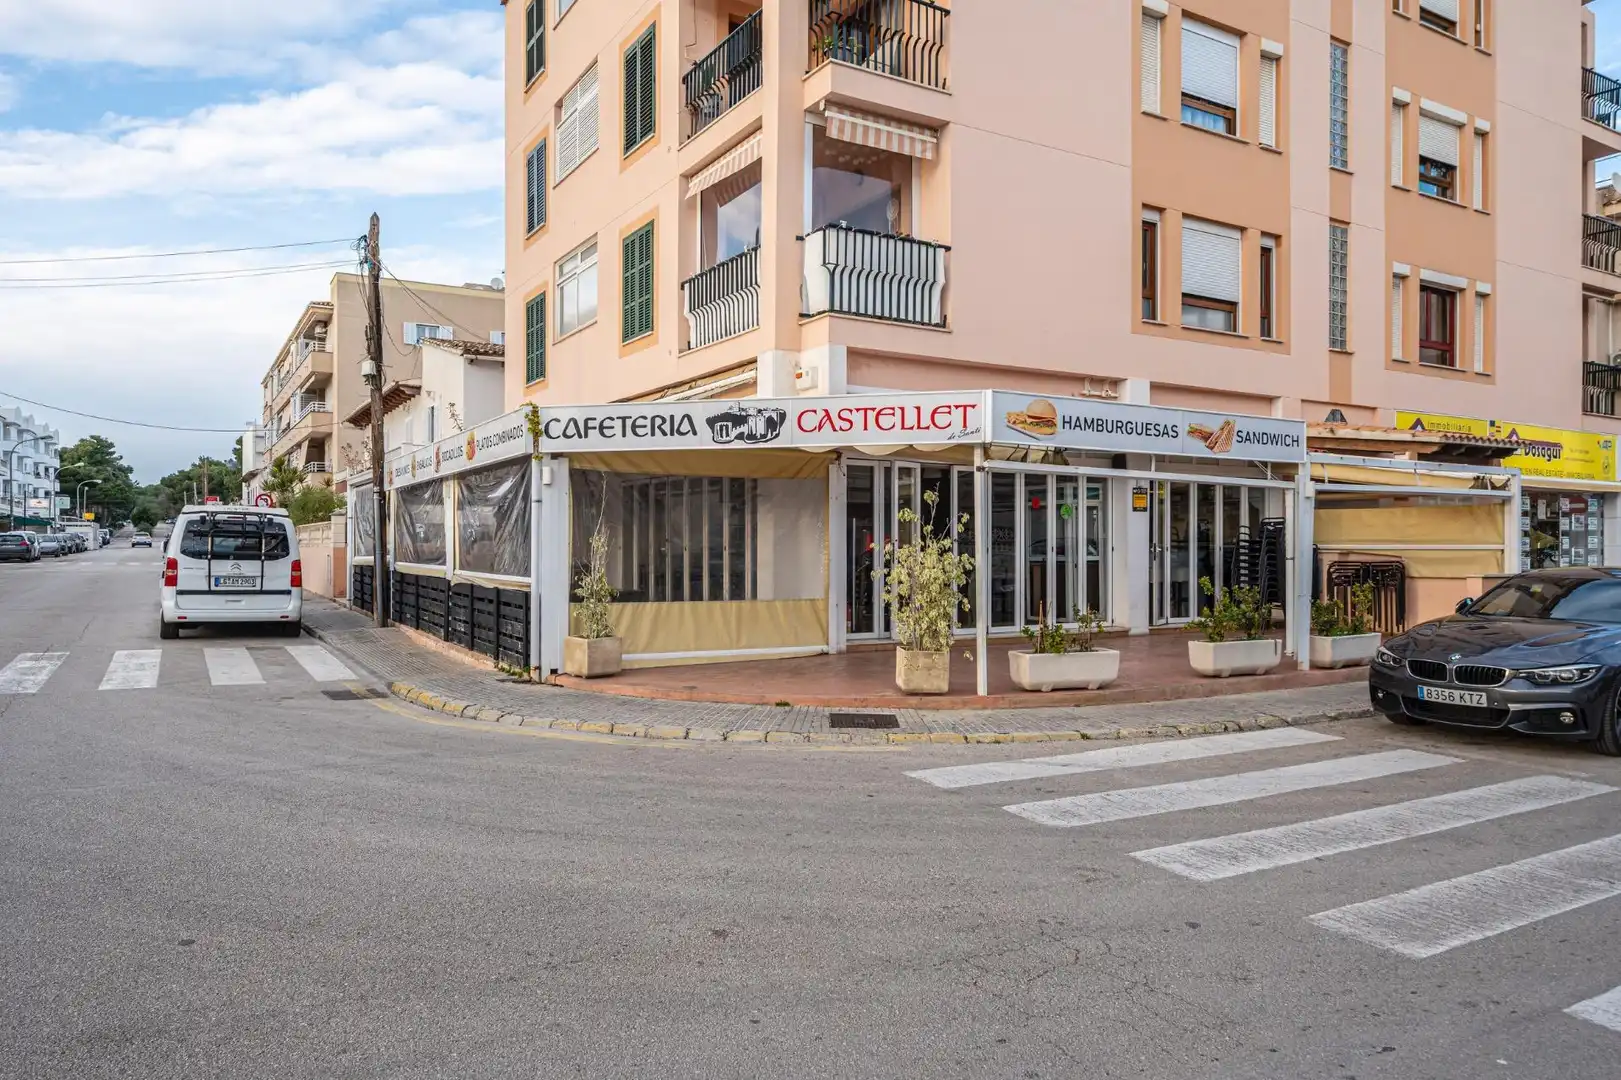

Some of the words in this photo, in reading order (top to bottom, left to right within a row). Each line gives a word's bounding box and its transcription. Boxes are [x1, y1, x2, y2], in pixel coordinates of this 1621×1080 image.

[543, 412, 698, 440] CAFETERIA
[797, 403, 979, 433] CASTELLET
[957, 426, 982, 438] Santi
[1062, 414, 1179, 439] HAMBURGUESAS
[476, 437, 493, 452] PLATOS
[493, 424, 524, 447] COMBINADOS
[1235, 430, 1300, 448] SANDWICH
[1426, 688, 1456, 703] 8356
[1459, 692, 1484, 705] KTZ
